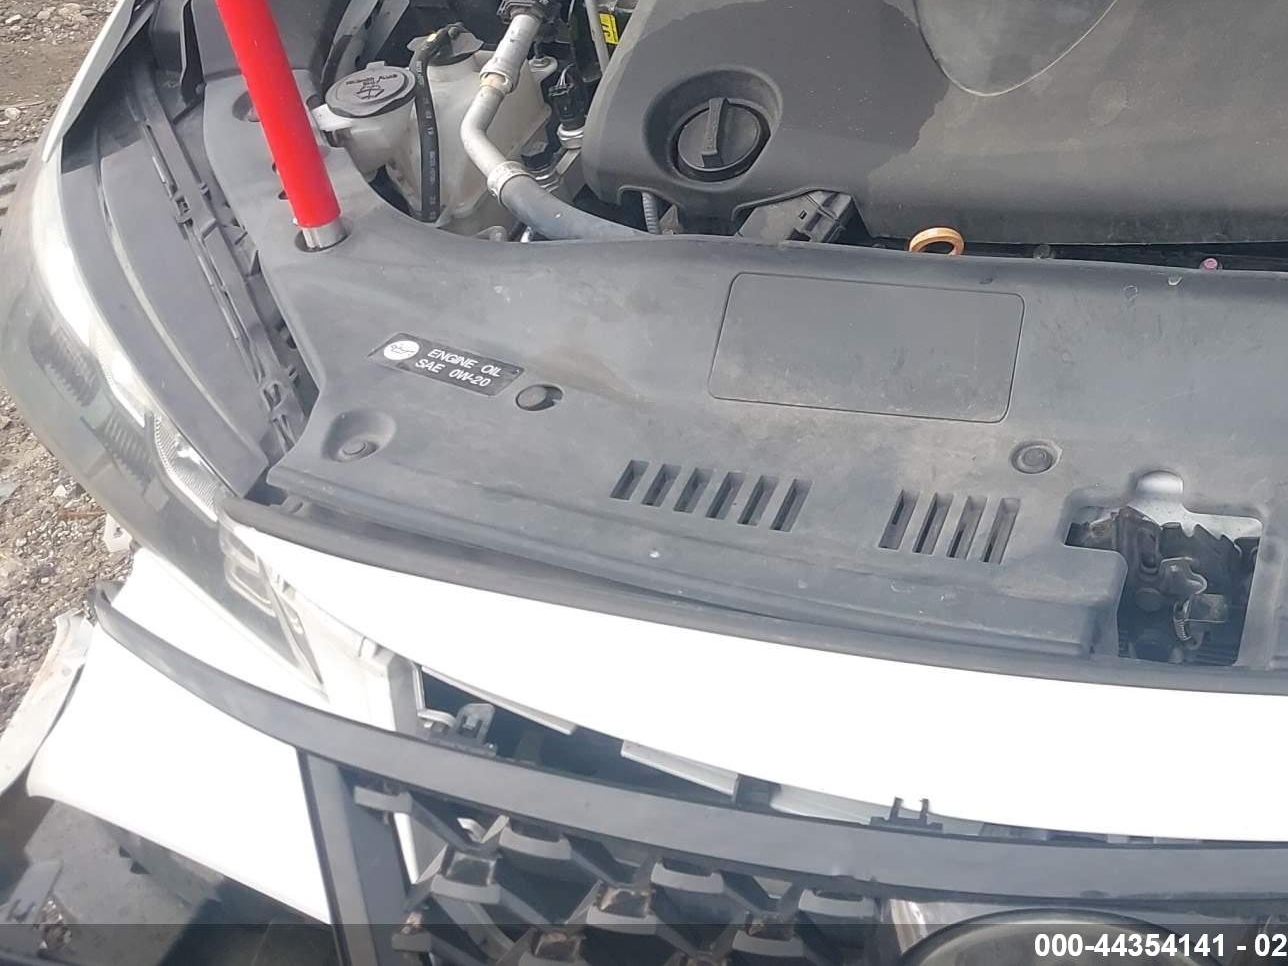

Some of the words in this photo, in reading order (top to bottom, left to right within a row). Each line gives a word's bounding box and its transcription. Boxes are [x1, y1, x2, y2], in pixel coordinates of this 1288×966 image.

[415, 358, 446, 374] SAE
[449, 368, 492, 387] 0W-20
[427, 348, 479, 369] ENGINE
[480, 364, 502, 378] OIL
